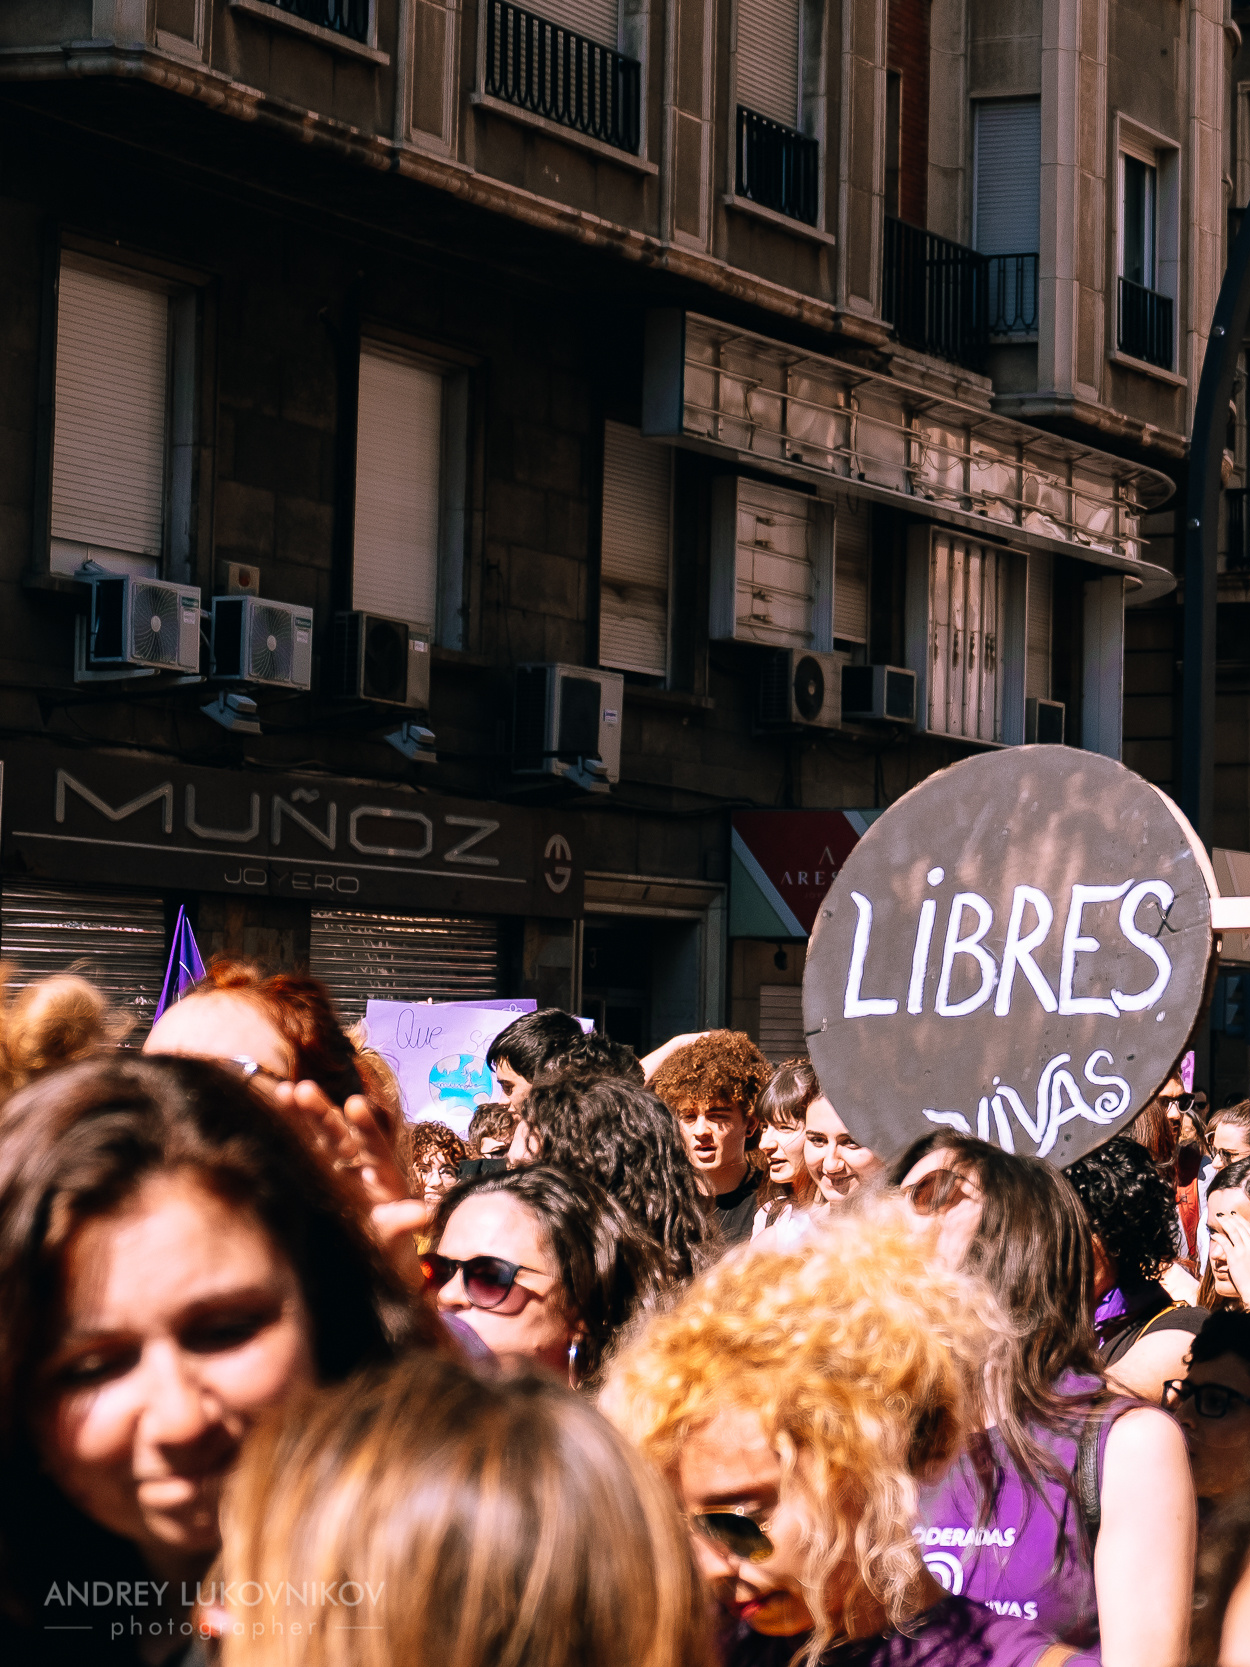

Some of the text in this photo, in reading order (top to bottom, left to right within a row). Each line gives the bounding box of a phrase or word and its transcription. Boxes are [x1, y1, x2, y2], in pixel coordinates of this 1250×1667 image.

[55, 768, 500, 866] MUÑOZ
[224, 867, 360, 894] JOYERO
[396, 1008, 442, 1050] Que
